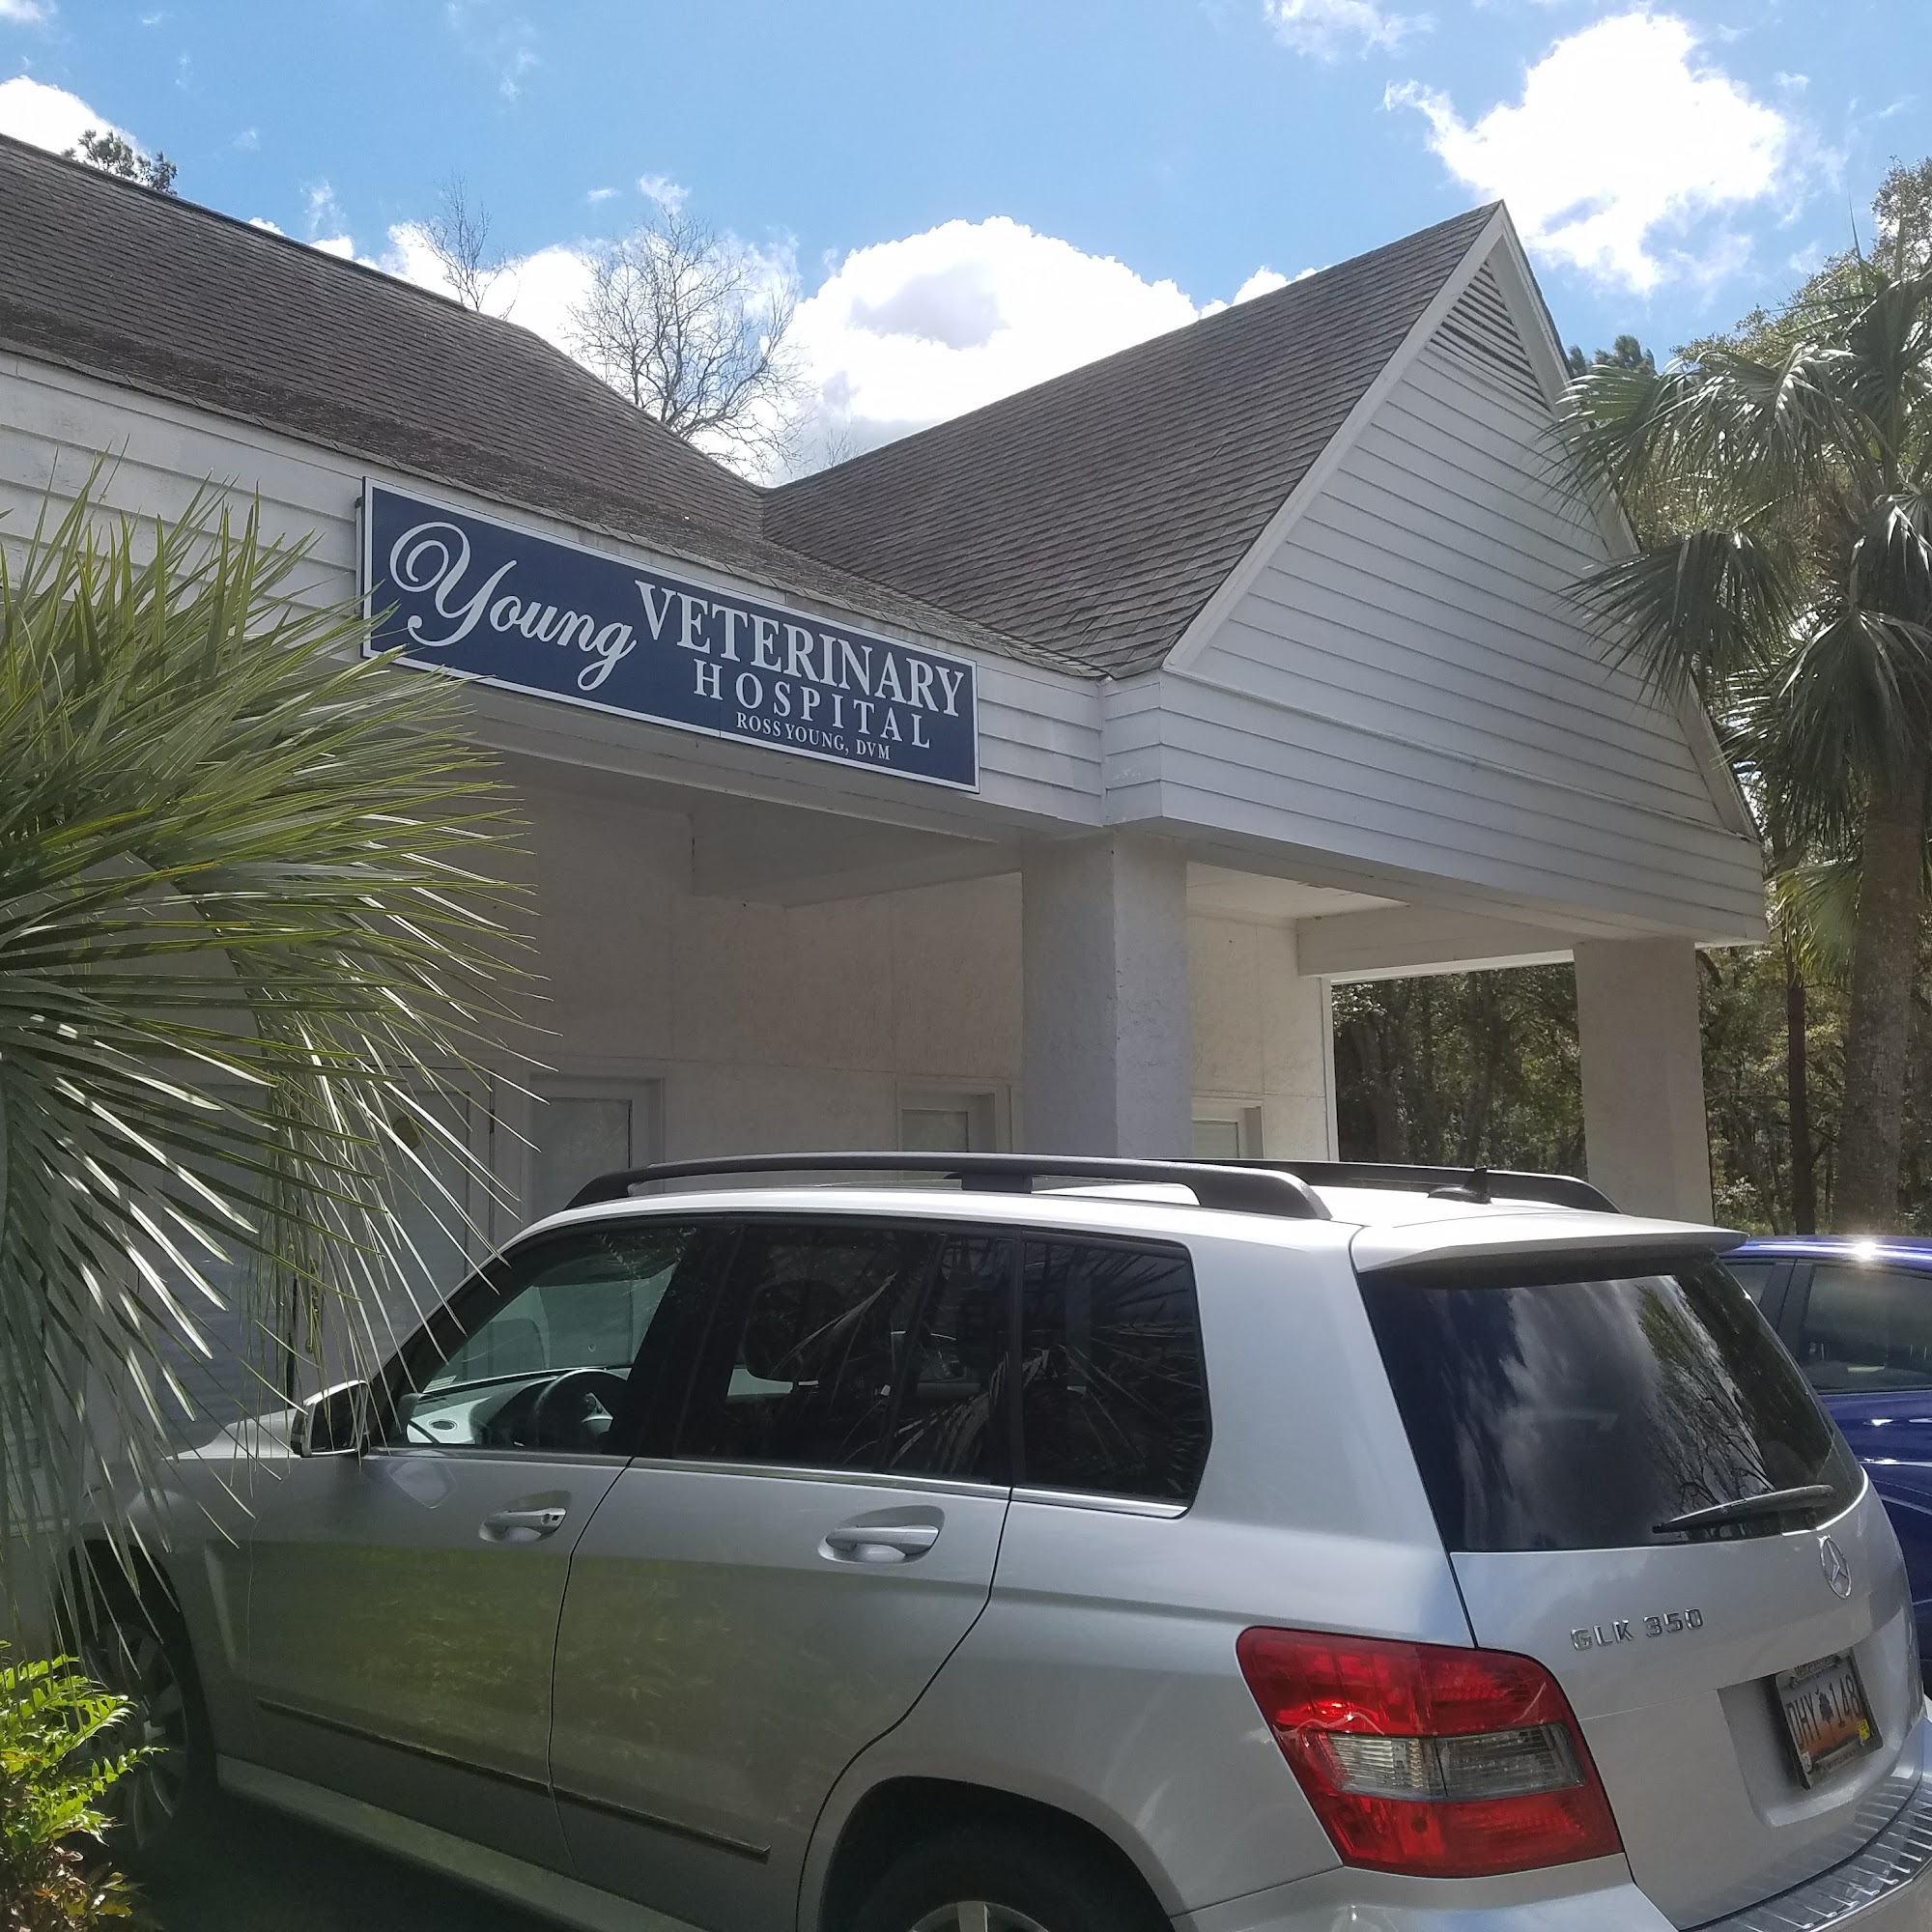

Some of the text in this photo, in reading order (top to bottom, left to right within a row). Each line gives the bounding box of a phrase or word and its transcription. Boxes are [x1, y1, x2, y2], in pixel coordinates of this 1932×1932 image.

[389, 521, 965, 717] Young VETERINARY
[693, 658, 930, 749] HOSPITAL
[735, 711, 891, 761] ROSS YOUNG, DVM
[1570, 1607, 1704, 1652] GLK 350
